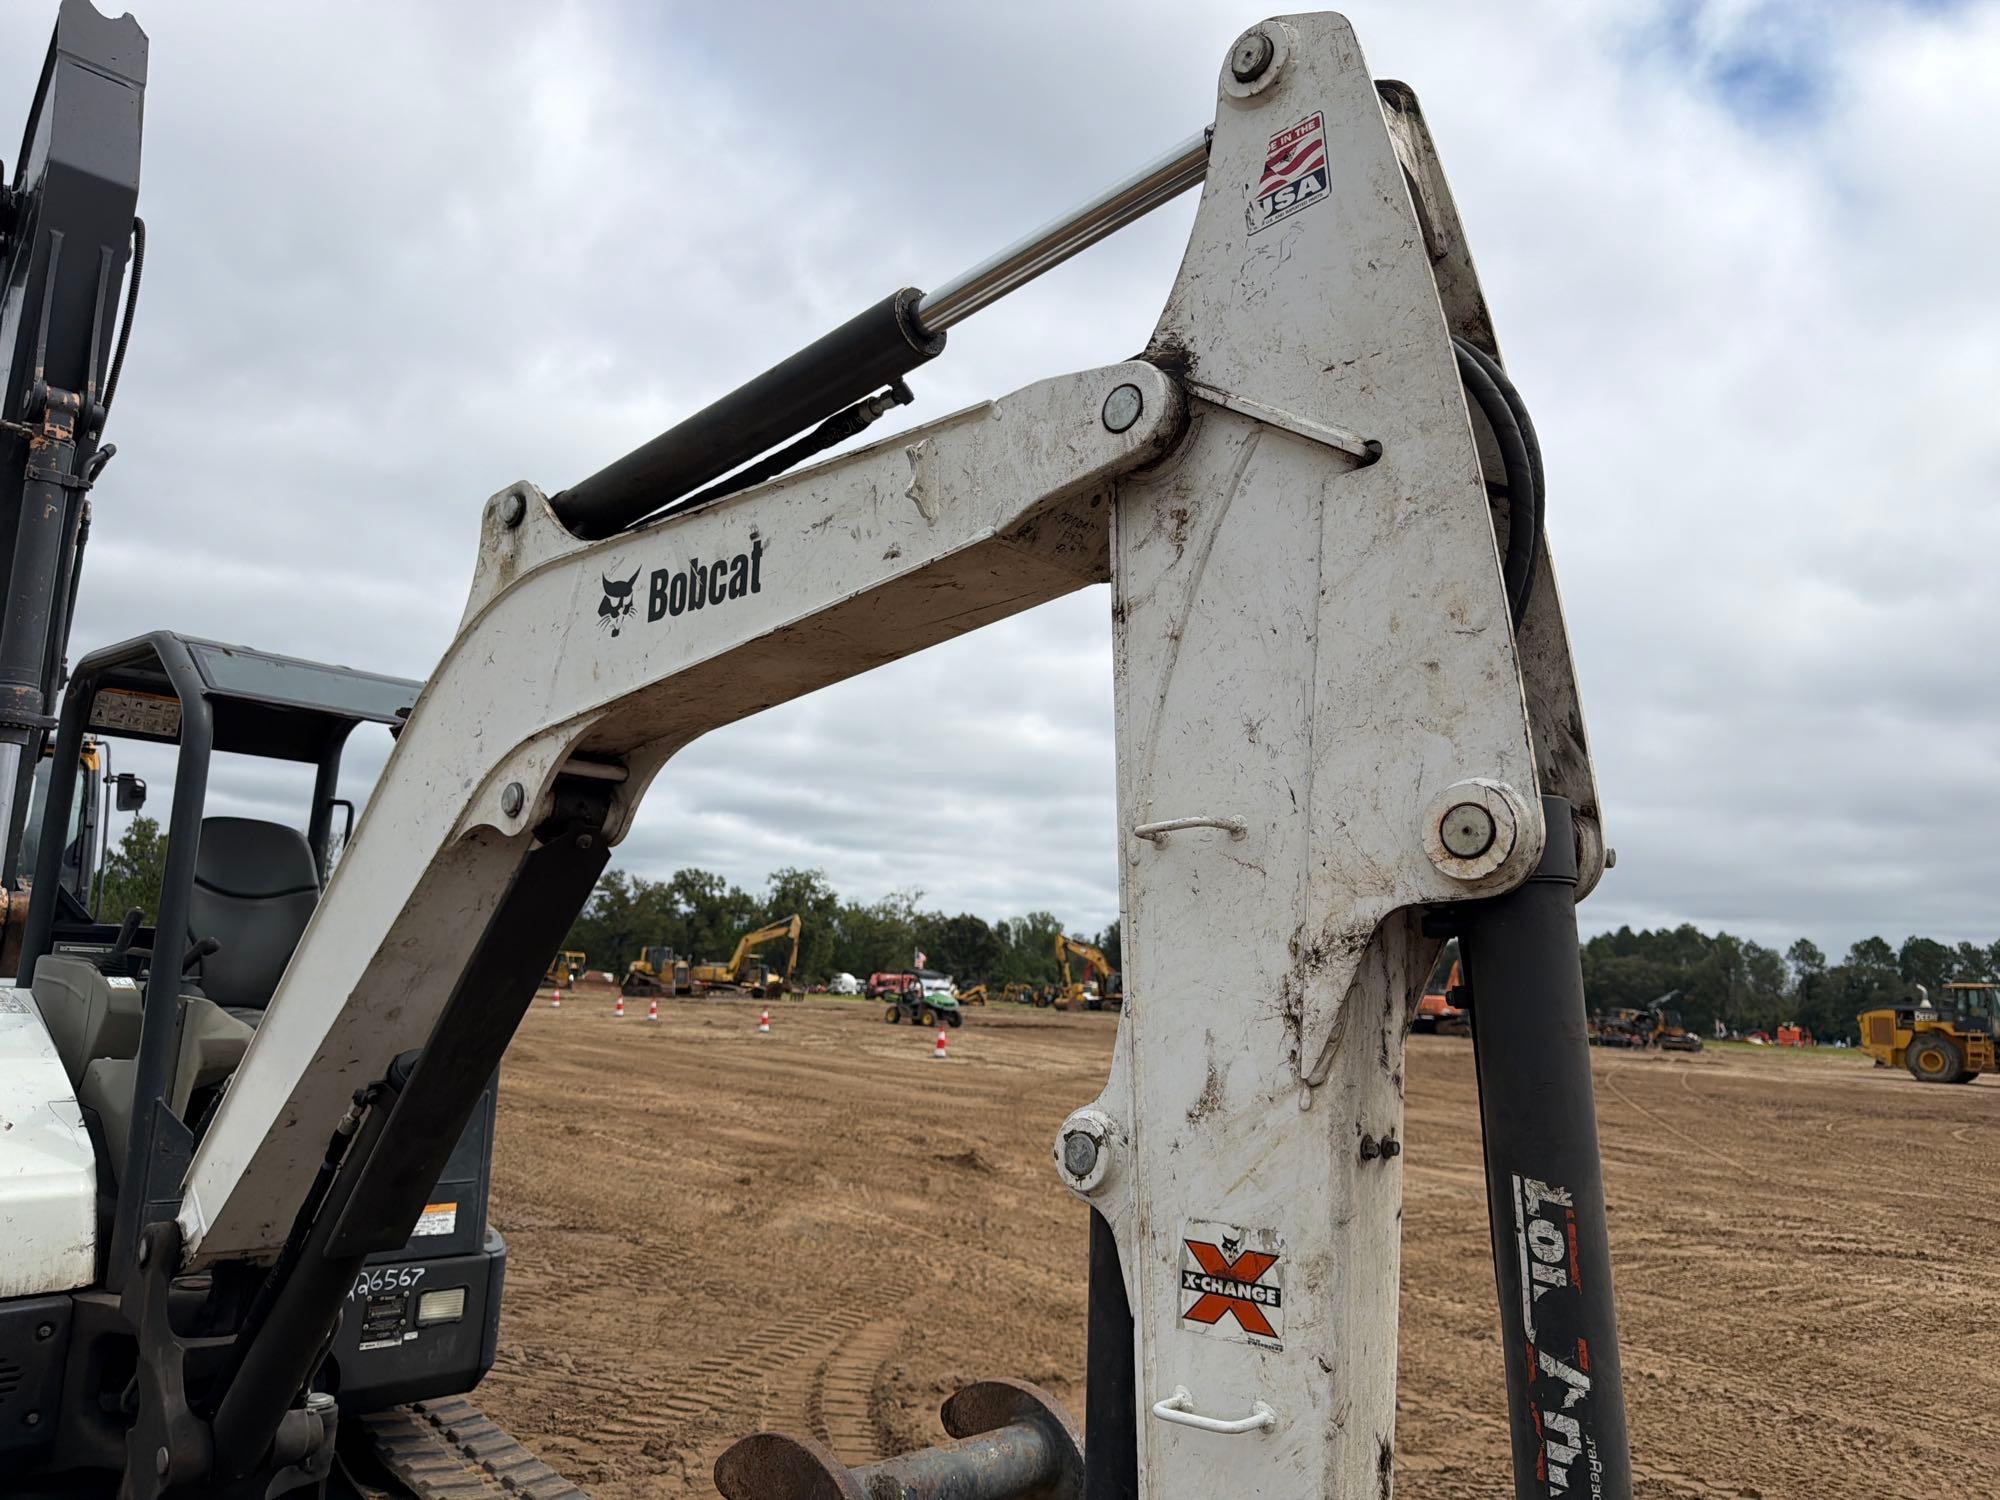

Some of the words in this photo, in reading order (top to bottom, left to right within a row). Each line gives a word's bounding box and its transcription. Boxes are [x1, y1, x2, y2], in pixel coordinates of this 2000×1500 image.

[1280, 134, 1293, 147] IN
[1295, 119, 1317, 137] THE
[647, 538, 764, 624] Bobcat
[1184, 1272, 1277, 1304] X-CHANGE
